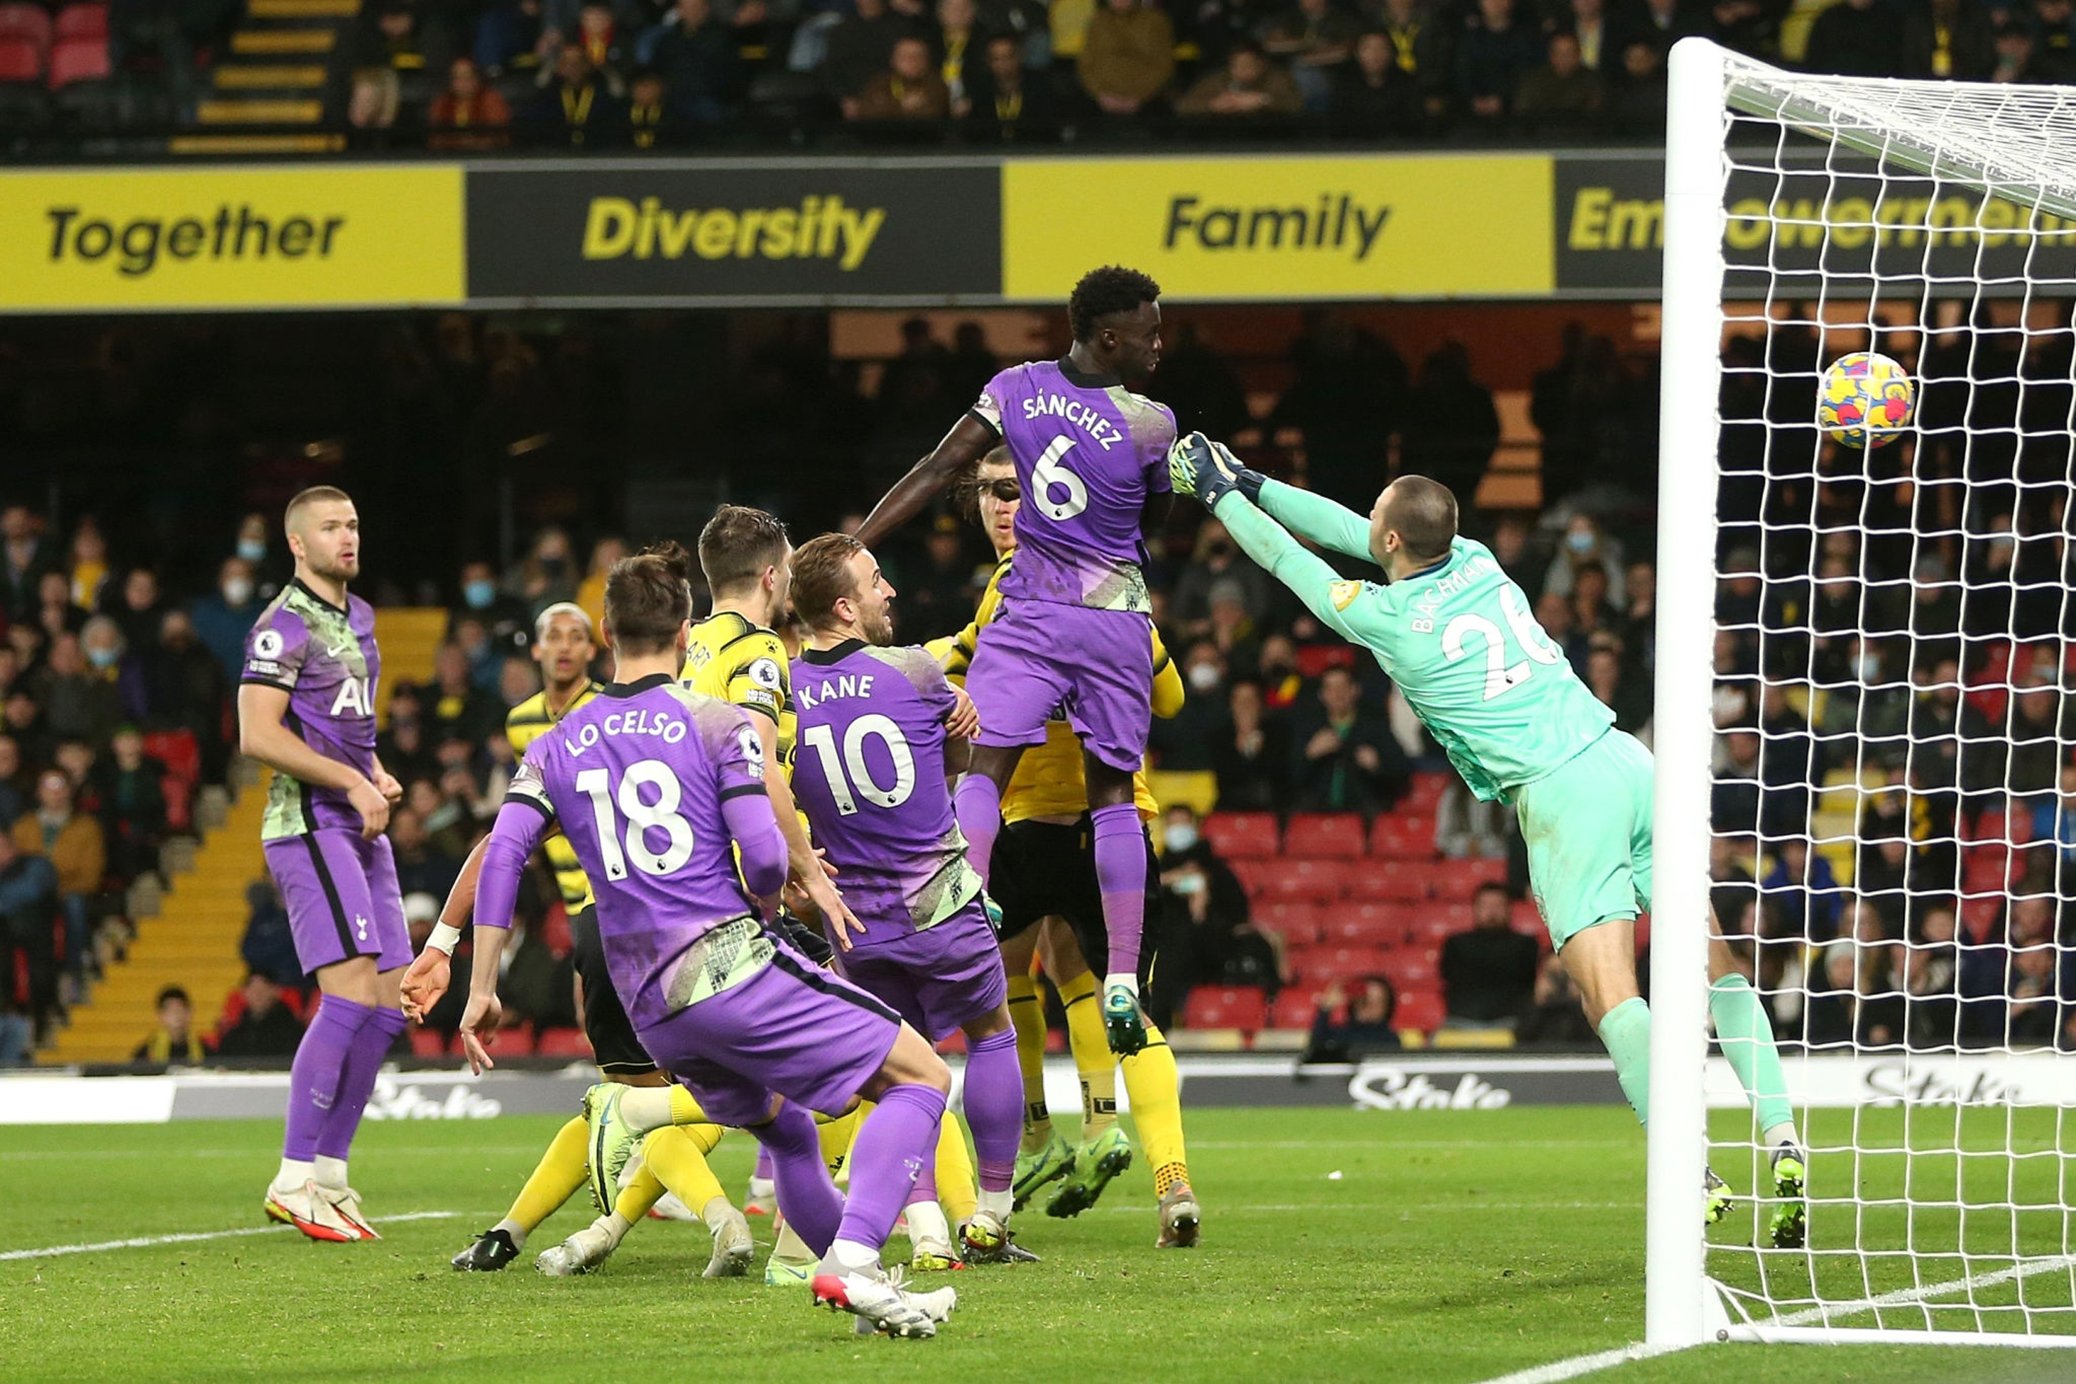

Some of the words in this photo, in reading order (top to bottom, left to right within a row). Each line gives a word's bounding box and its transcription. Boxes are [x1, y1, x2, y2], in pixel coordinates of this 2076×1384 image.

[46, 206, 344, 276] Together
[582, 196, 886, 271] Diversity
[1164, 192, 1391, 262] Family
[1568, 187, 2076, 250] Emowermen
[1023, 388, 1124, 451] SÁNCHEZ
[1031, 434, 1088, 521] 6
[1441, 581, 1560, 702] 26
[798, 675, 874, 710] KANE
[565, 723, 599, 757] LO
[604, 709, 687, 744] CELSO
[804, 714, 916, 817] 10
[575, 759, 695, 882] 18
[1348, 1066, 1511, 1111] Stake
[1865, 1059, 2023, 1106] Stake
